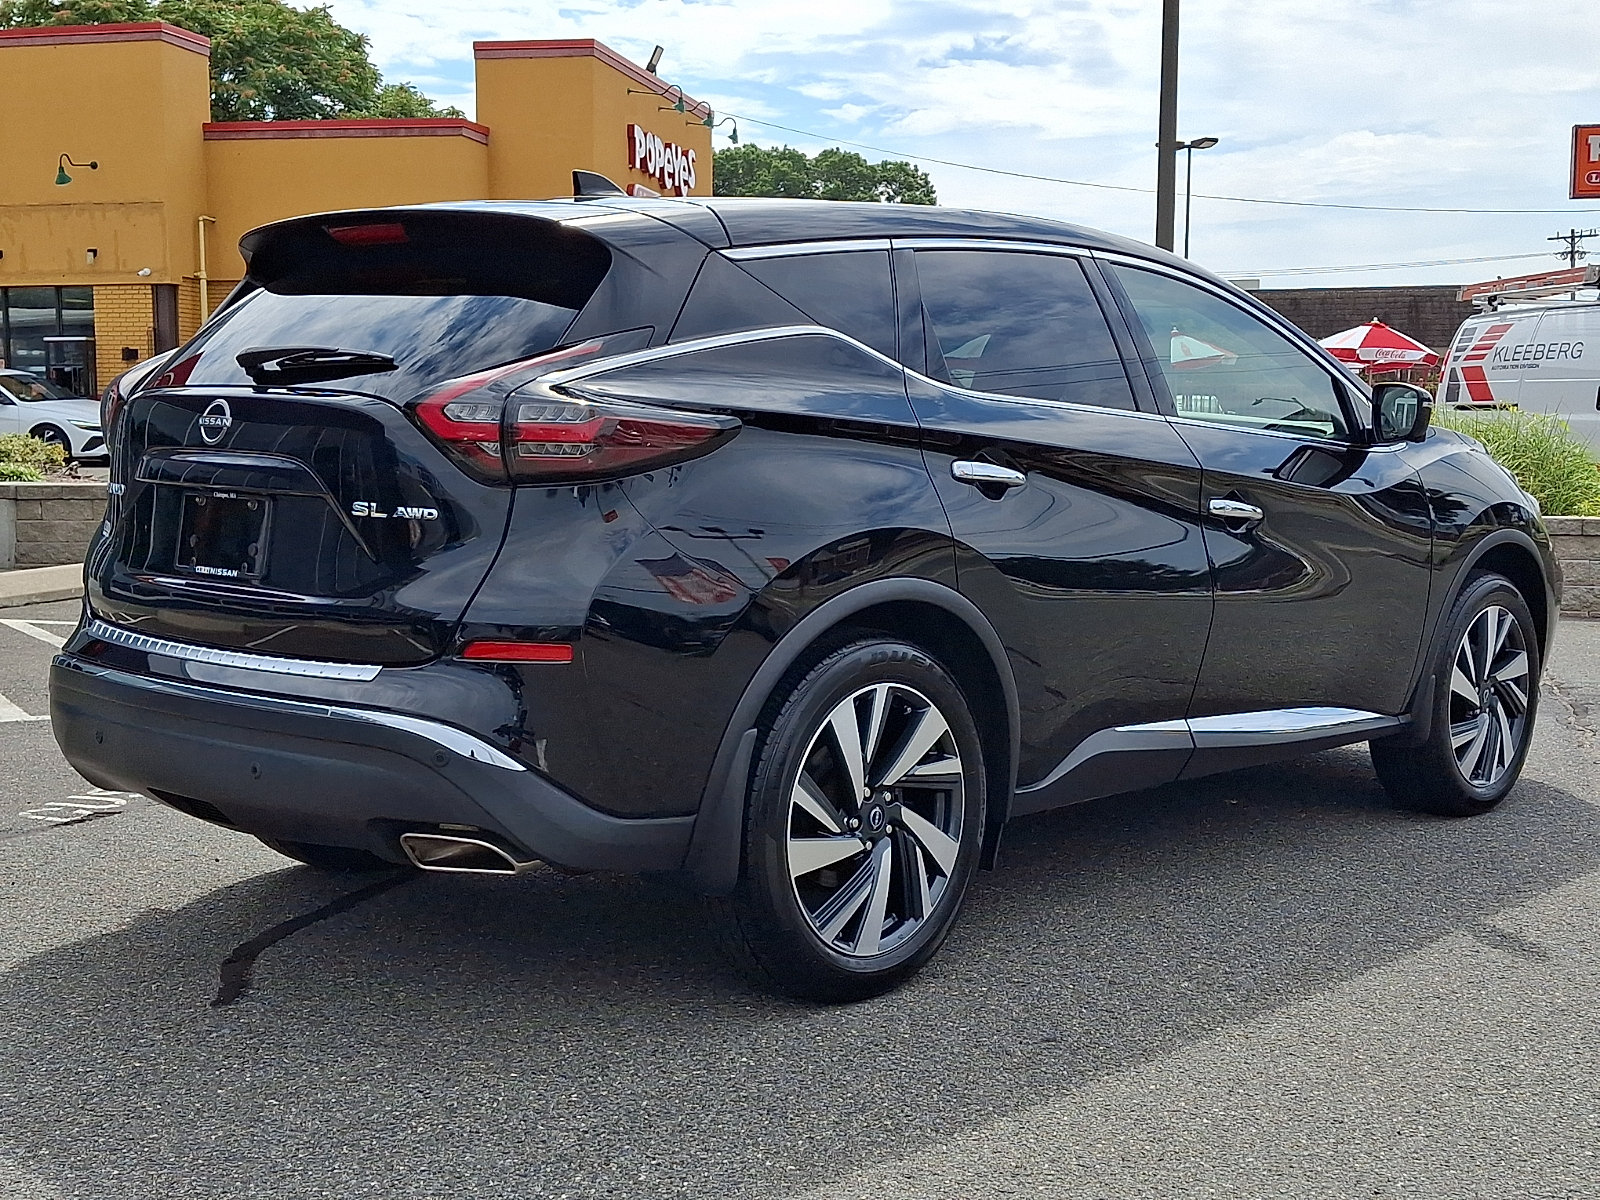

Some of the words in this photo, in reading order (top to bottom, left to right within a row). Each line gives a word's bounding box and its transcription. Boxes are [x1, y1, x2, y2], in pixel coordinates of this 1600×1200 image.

[1492, 341, 1584, 363] KLEEBERG
[351, 501, 388, 519] SL
[392, 506, 439, 521] AWD
[210, 567, 238, 577] NISSAN
